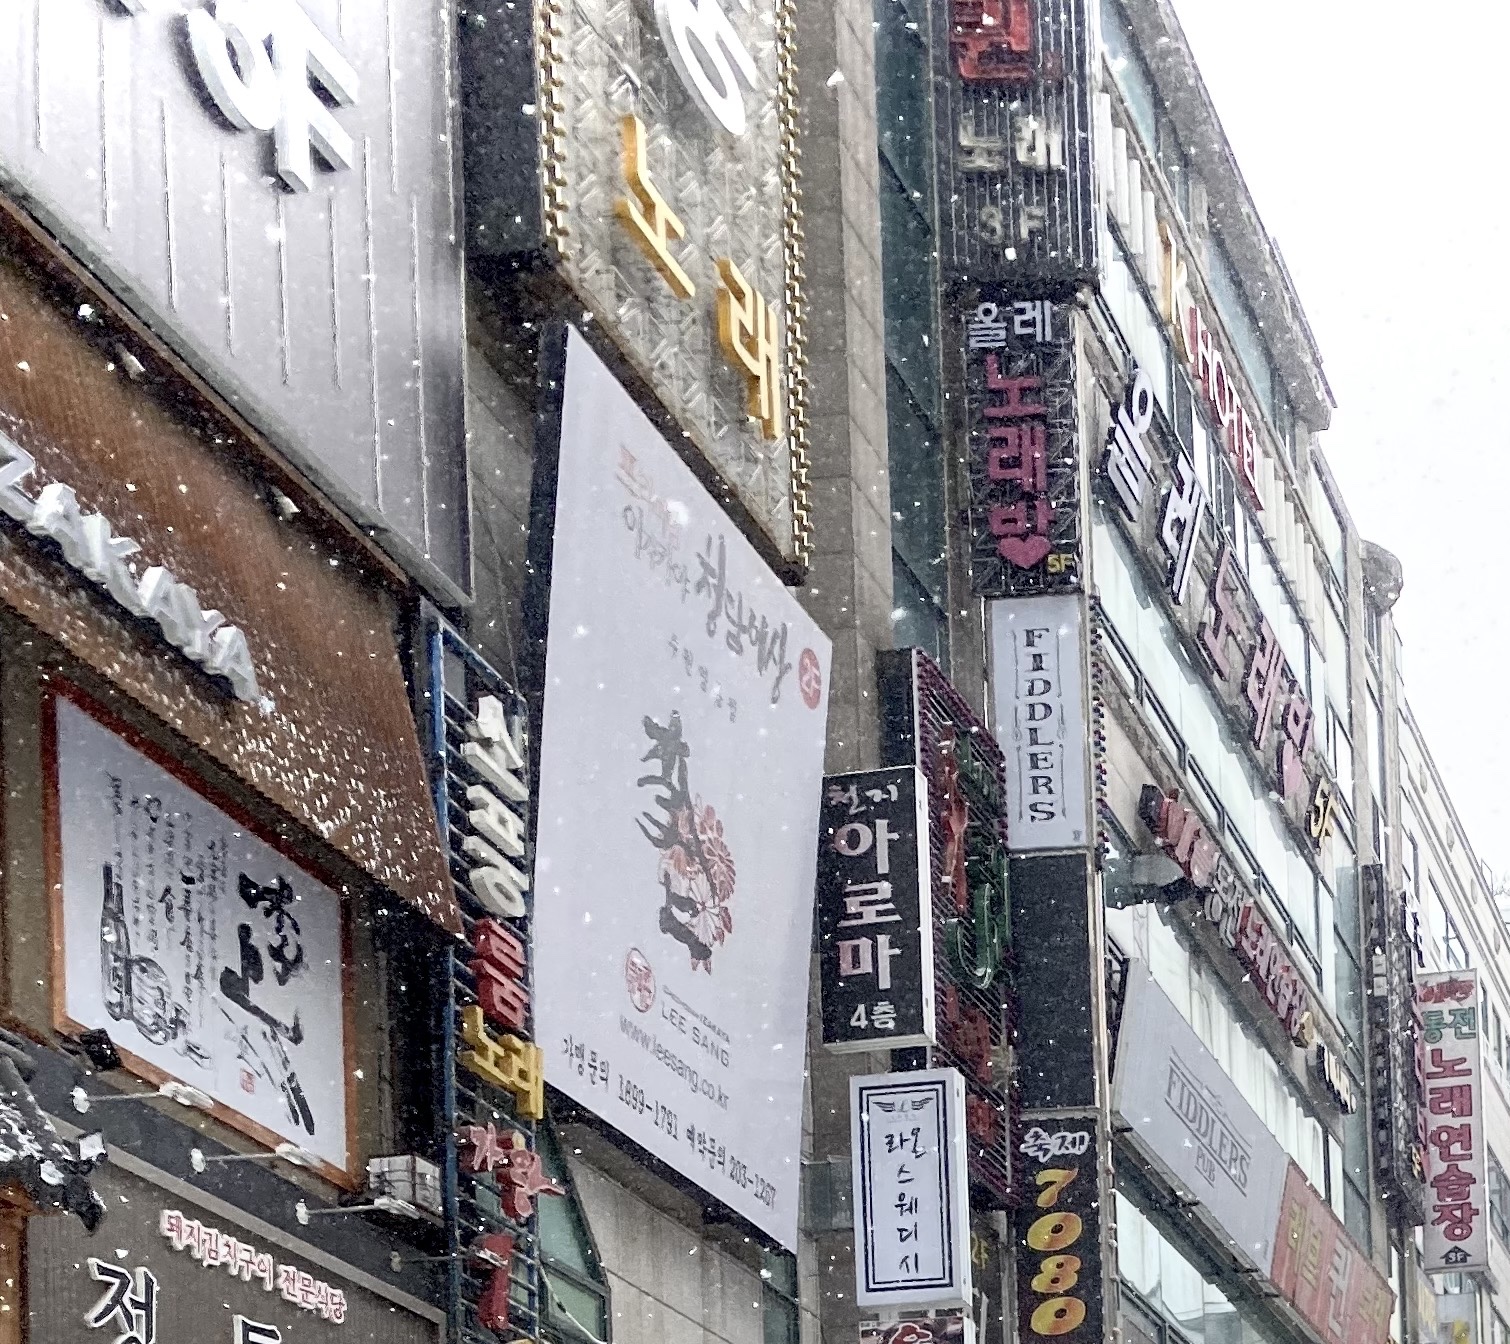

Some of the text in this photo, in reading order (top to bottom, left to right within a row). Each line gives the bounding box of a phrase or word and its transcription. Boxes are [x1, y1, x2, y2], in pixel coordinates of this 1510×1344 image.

[968, 299, 1052, 348] 올레
[1024, 627, 1056, 824] FIDDLERS
[830, 819, 903, 990] 아로마
[851, 1002, 896, 1030] 4층
[1167, 1067, 1250, 1189] FIDDLERS
[1426, 1048, 1479, 1241] 노래연습장
[1027, 1168, 1086, 1335] 7080
